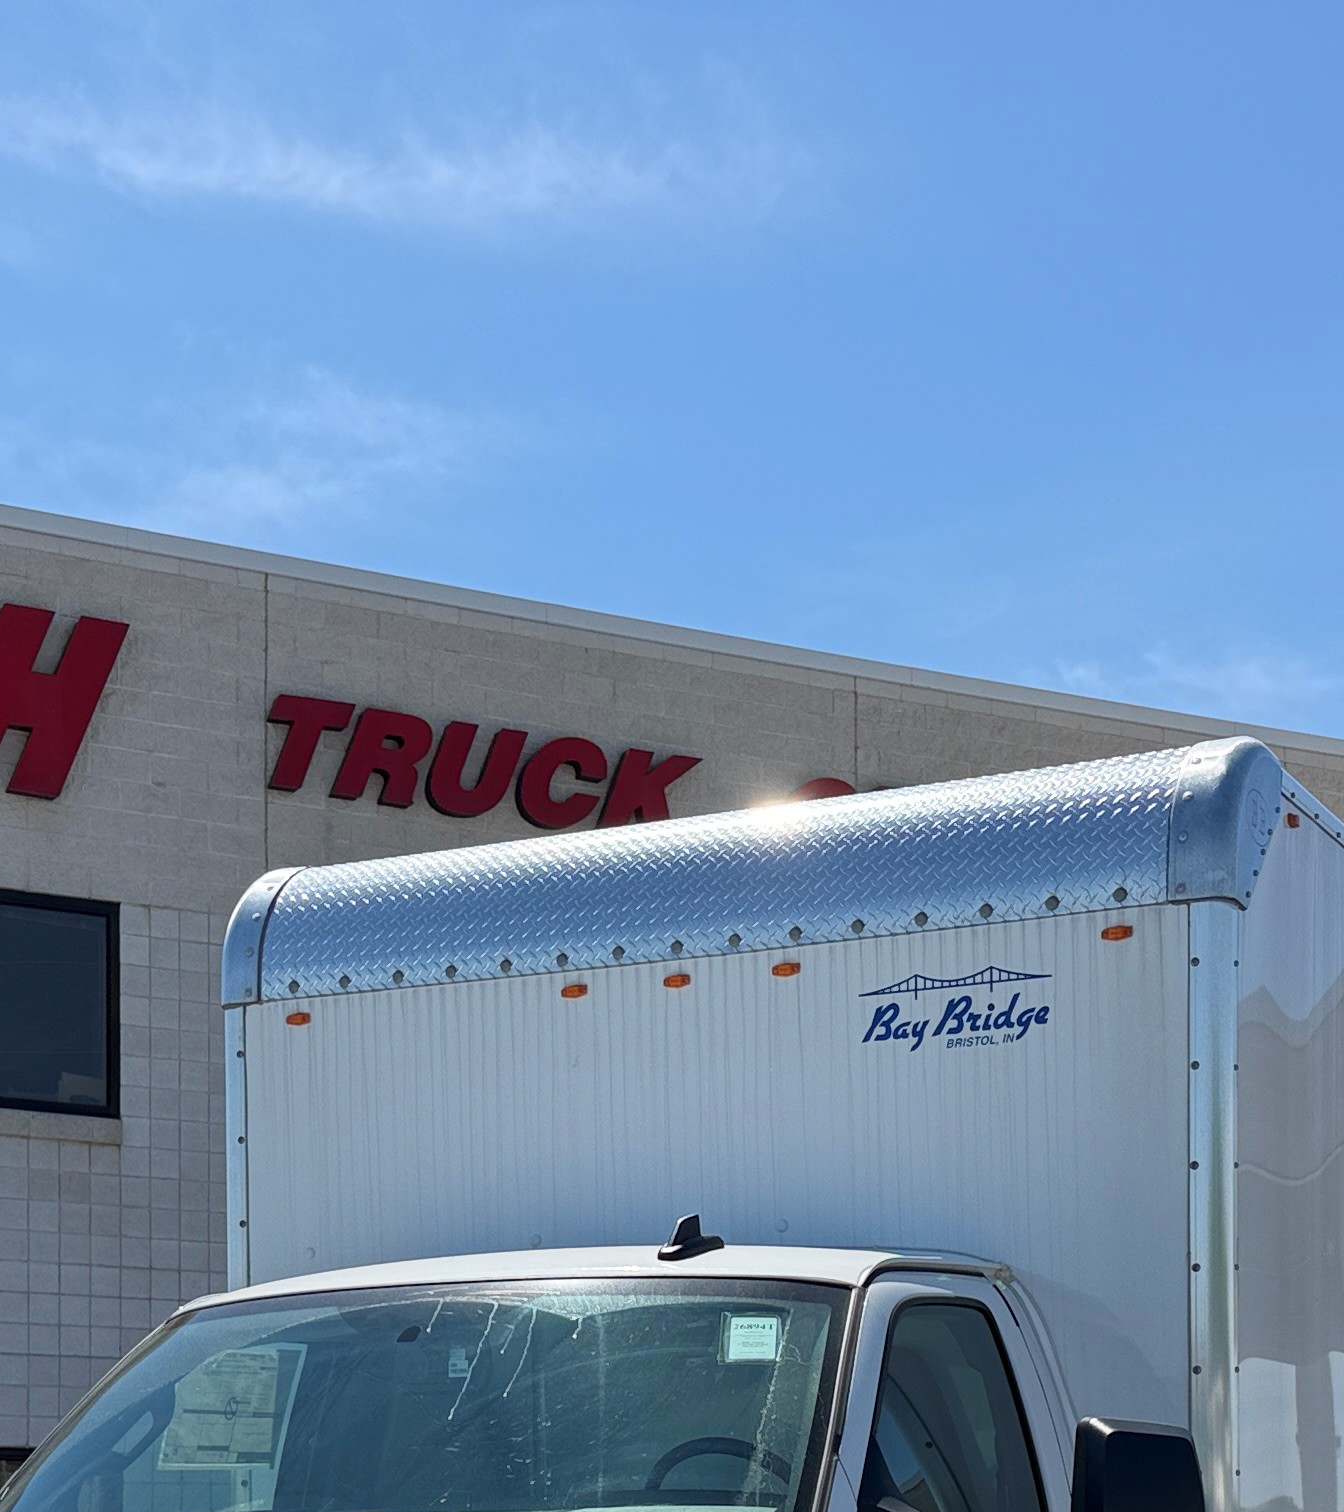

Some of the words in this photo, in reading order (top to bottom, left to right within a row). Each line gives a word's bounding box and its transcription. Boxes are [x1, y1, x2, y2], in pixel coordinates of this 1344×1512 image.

[267, 694, 703, 830] TRUCK
[861, 1002, 930, 1052] Bay
[932, 992, 1050, 1041] Bridge
[946, 1034, 999, 1049] BRISTOL,
[1002, 1033, 1015, 1044] IN
